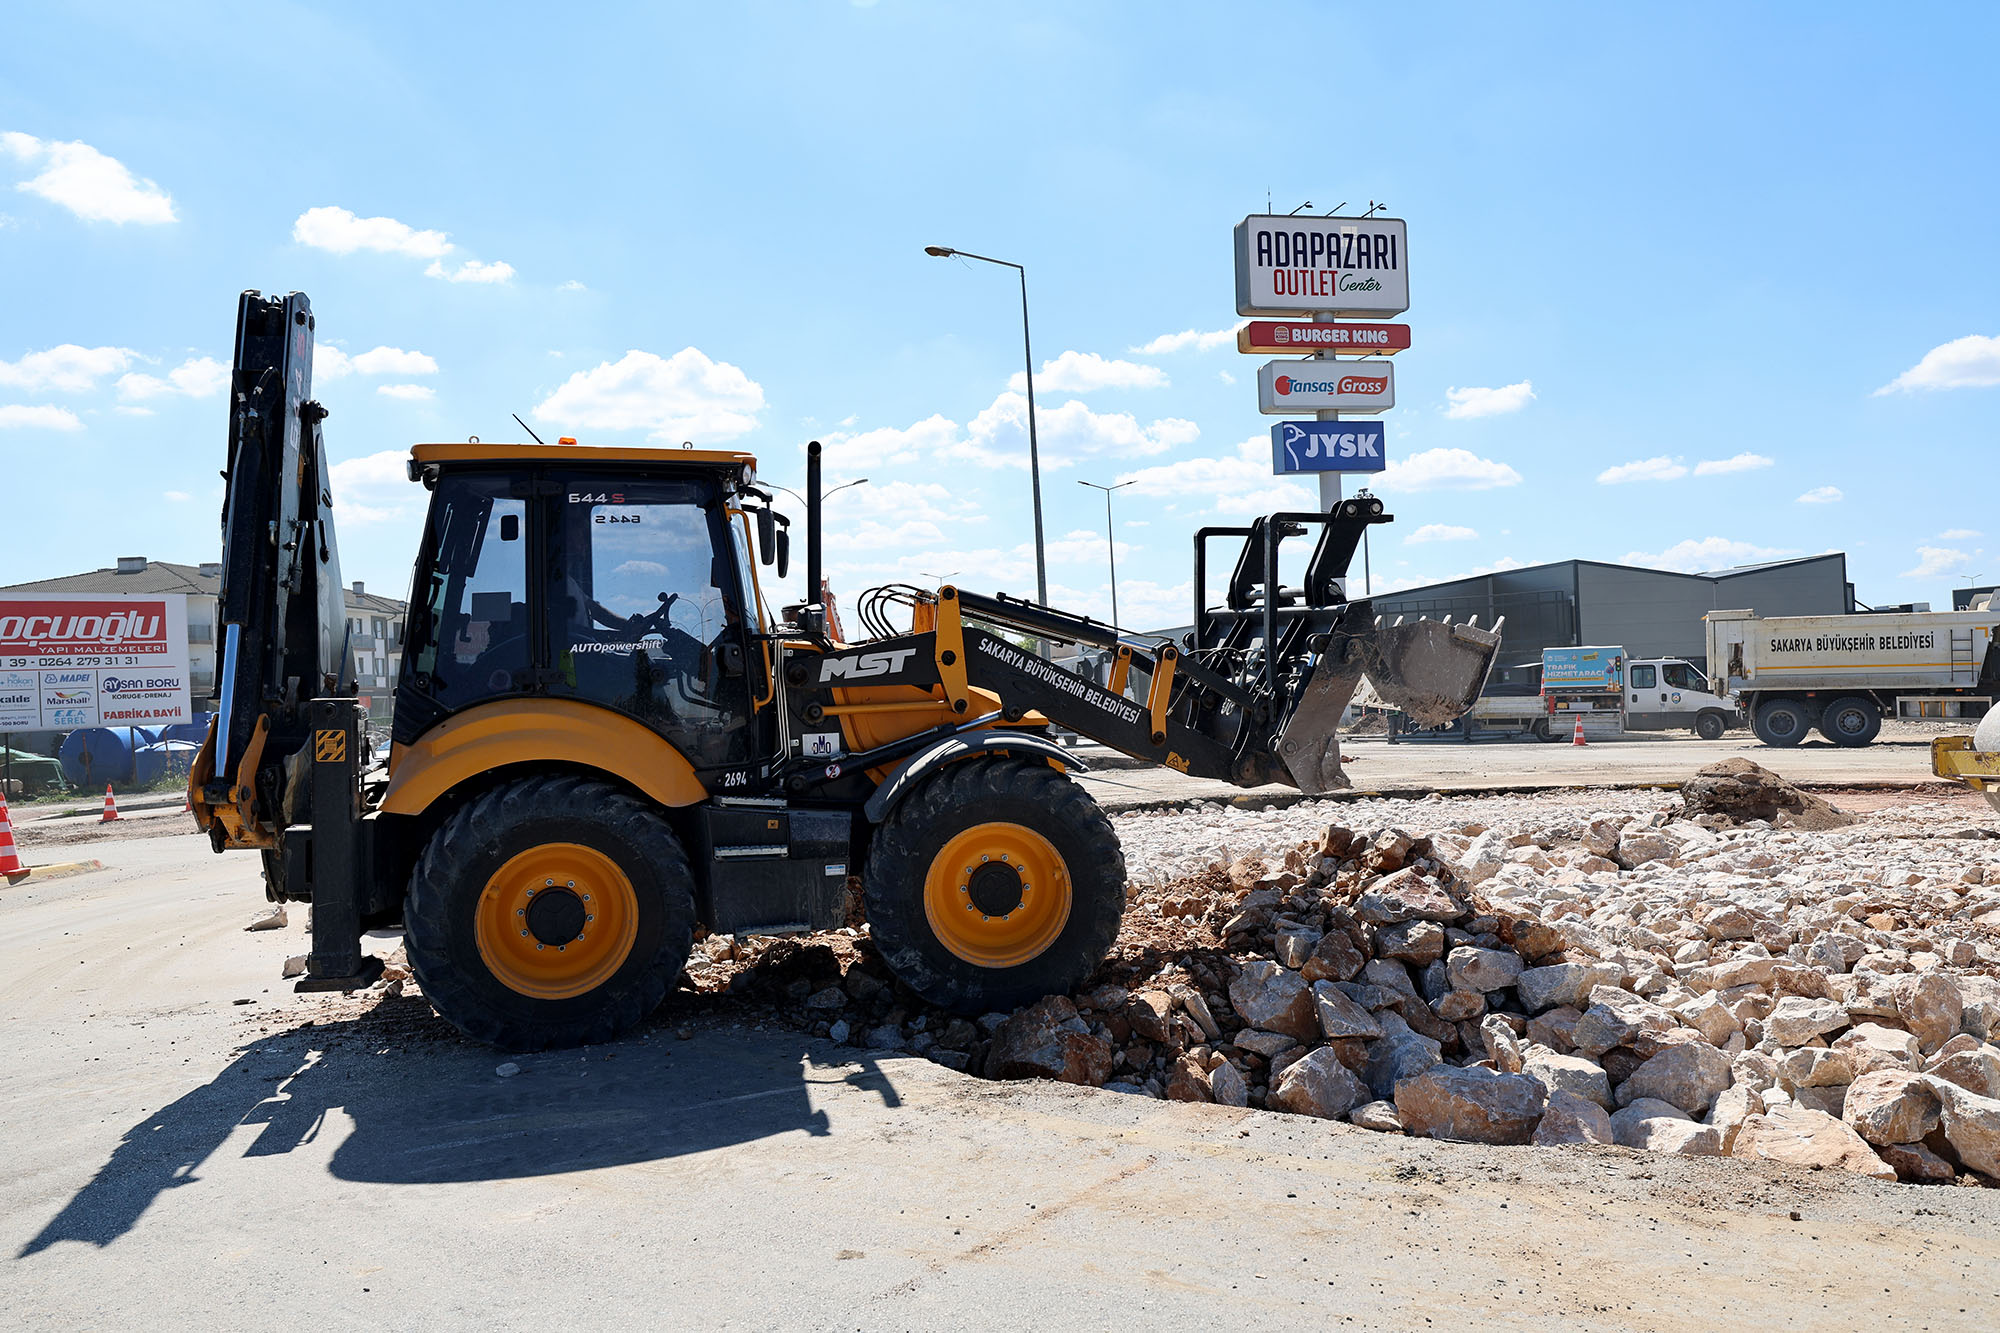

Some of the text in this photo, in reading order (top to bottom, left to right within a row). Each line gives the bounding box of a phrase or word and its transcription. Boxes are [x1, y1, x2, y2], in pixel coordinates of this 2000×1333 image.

[1257, 231, 1397, 270] ADAPAZARI
[1273, 268, 1382, 296] OUTLET Center
[1292, 328, 1350, 343] BURGER
[1352, 329, 1389, 344] KING
[1341, 378, 1382, 393] Gross
[1305, 433, 1379, 458] JYSK
[568, 493, 625, 504] 644 S
[569, 640, 661, 653] AUTOpowershift
[1771, 631, 1934, 653] SAKARYA BÜYÜKŞEHİR BELEDİYESİ
[39, 645, 165, 654] YAPI MALZEMELERİ
[9, 658, 27, 667] 39
[39, 657, 72, 667] 0264
[76, 657, 101, 666] 279
[105, 657, 119, 665] 31
[125, 656, 139, 665] 31
[818, 647, 917, 682] MST
[60, 674, 90, 683] MAPEI
[146, 678, 180, 688] BORU
[978, 637, 1142, 724] SAKARYA BÜYÜKŞEHİR BELEDİYESİ
[47, 697, 87, 705] Marshall
[112, 692, 172, 700] KORUGE-DRENAJ
[103, 708, 152, 720] FABRİKA
[54, 717, 86, 725] SEREL
[724, 771, 747, 787] 2694
